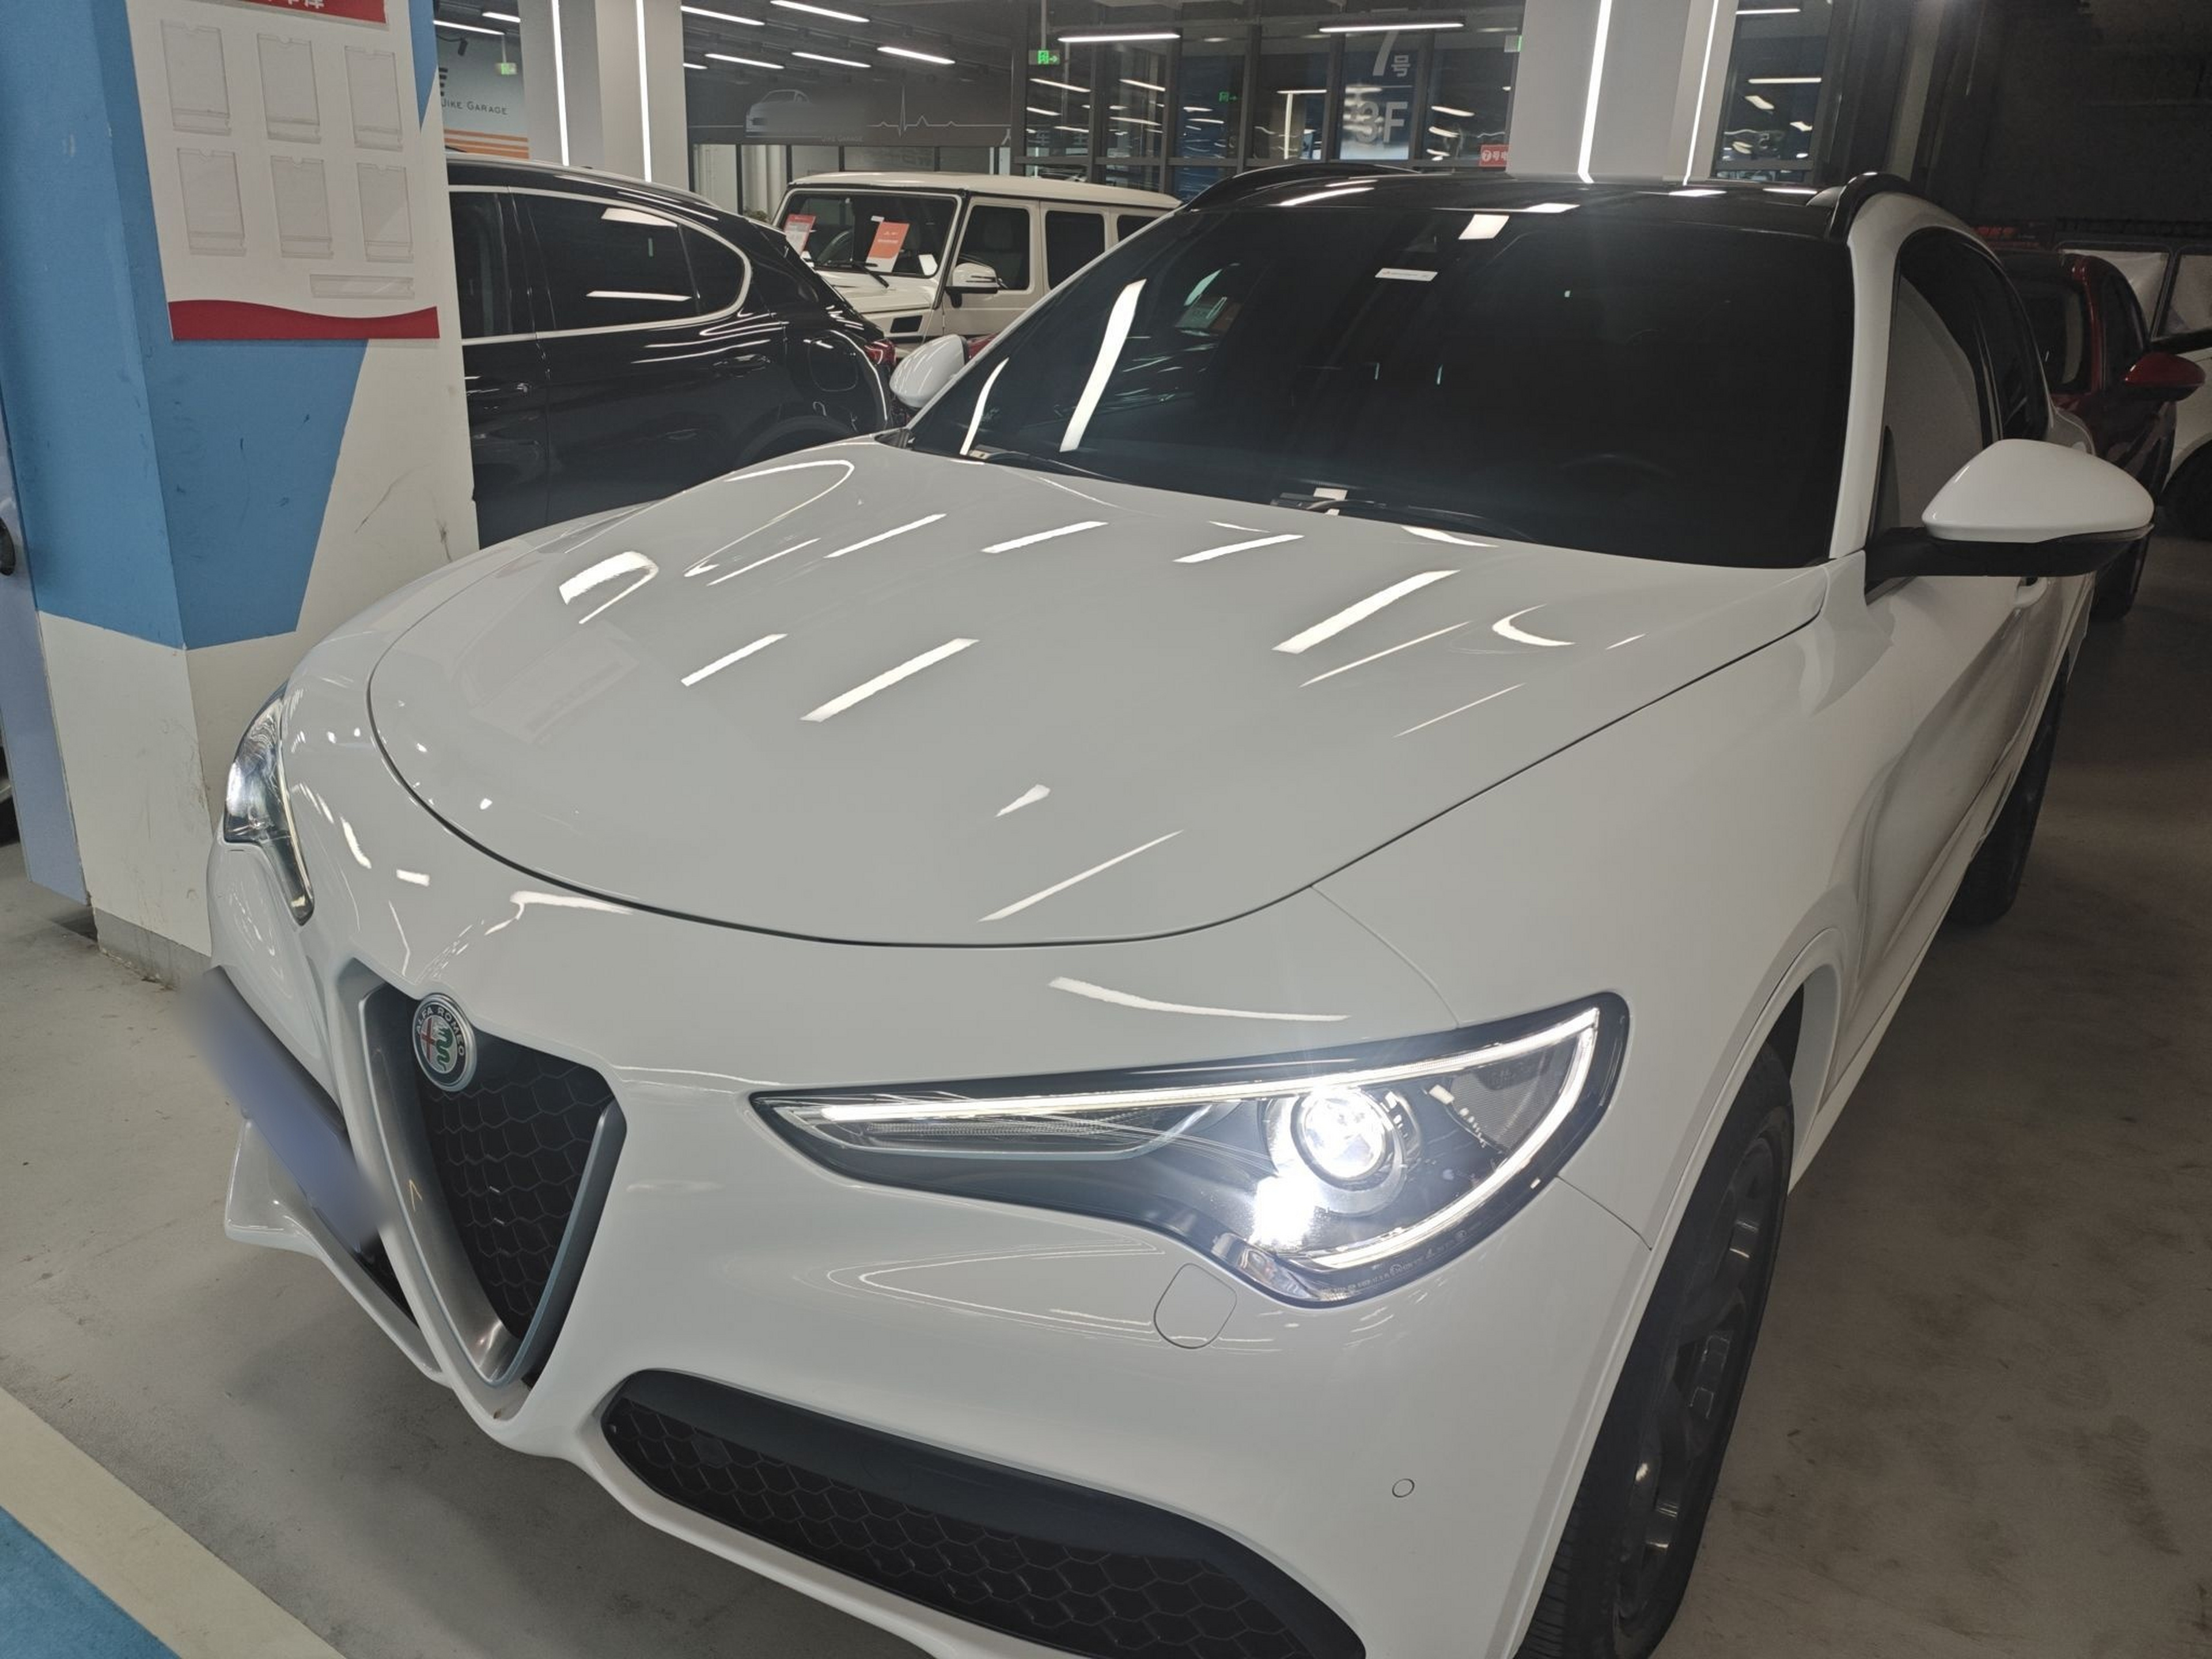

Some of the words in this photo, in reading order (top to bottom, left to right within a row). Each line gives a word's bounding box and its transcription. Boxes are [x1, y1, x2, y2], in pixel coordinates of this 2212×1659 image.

[467, 101, 508, 115] GARAGE
[1356, 101, 1408, 144] 3F
[416, 1007, 433, 1035] ALFA
[437, 1007, 465, 1056] ROMEO
